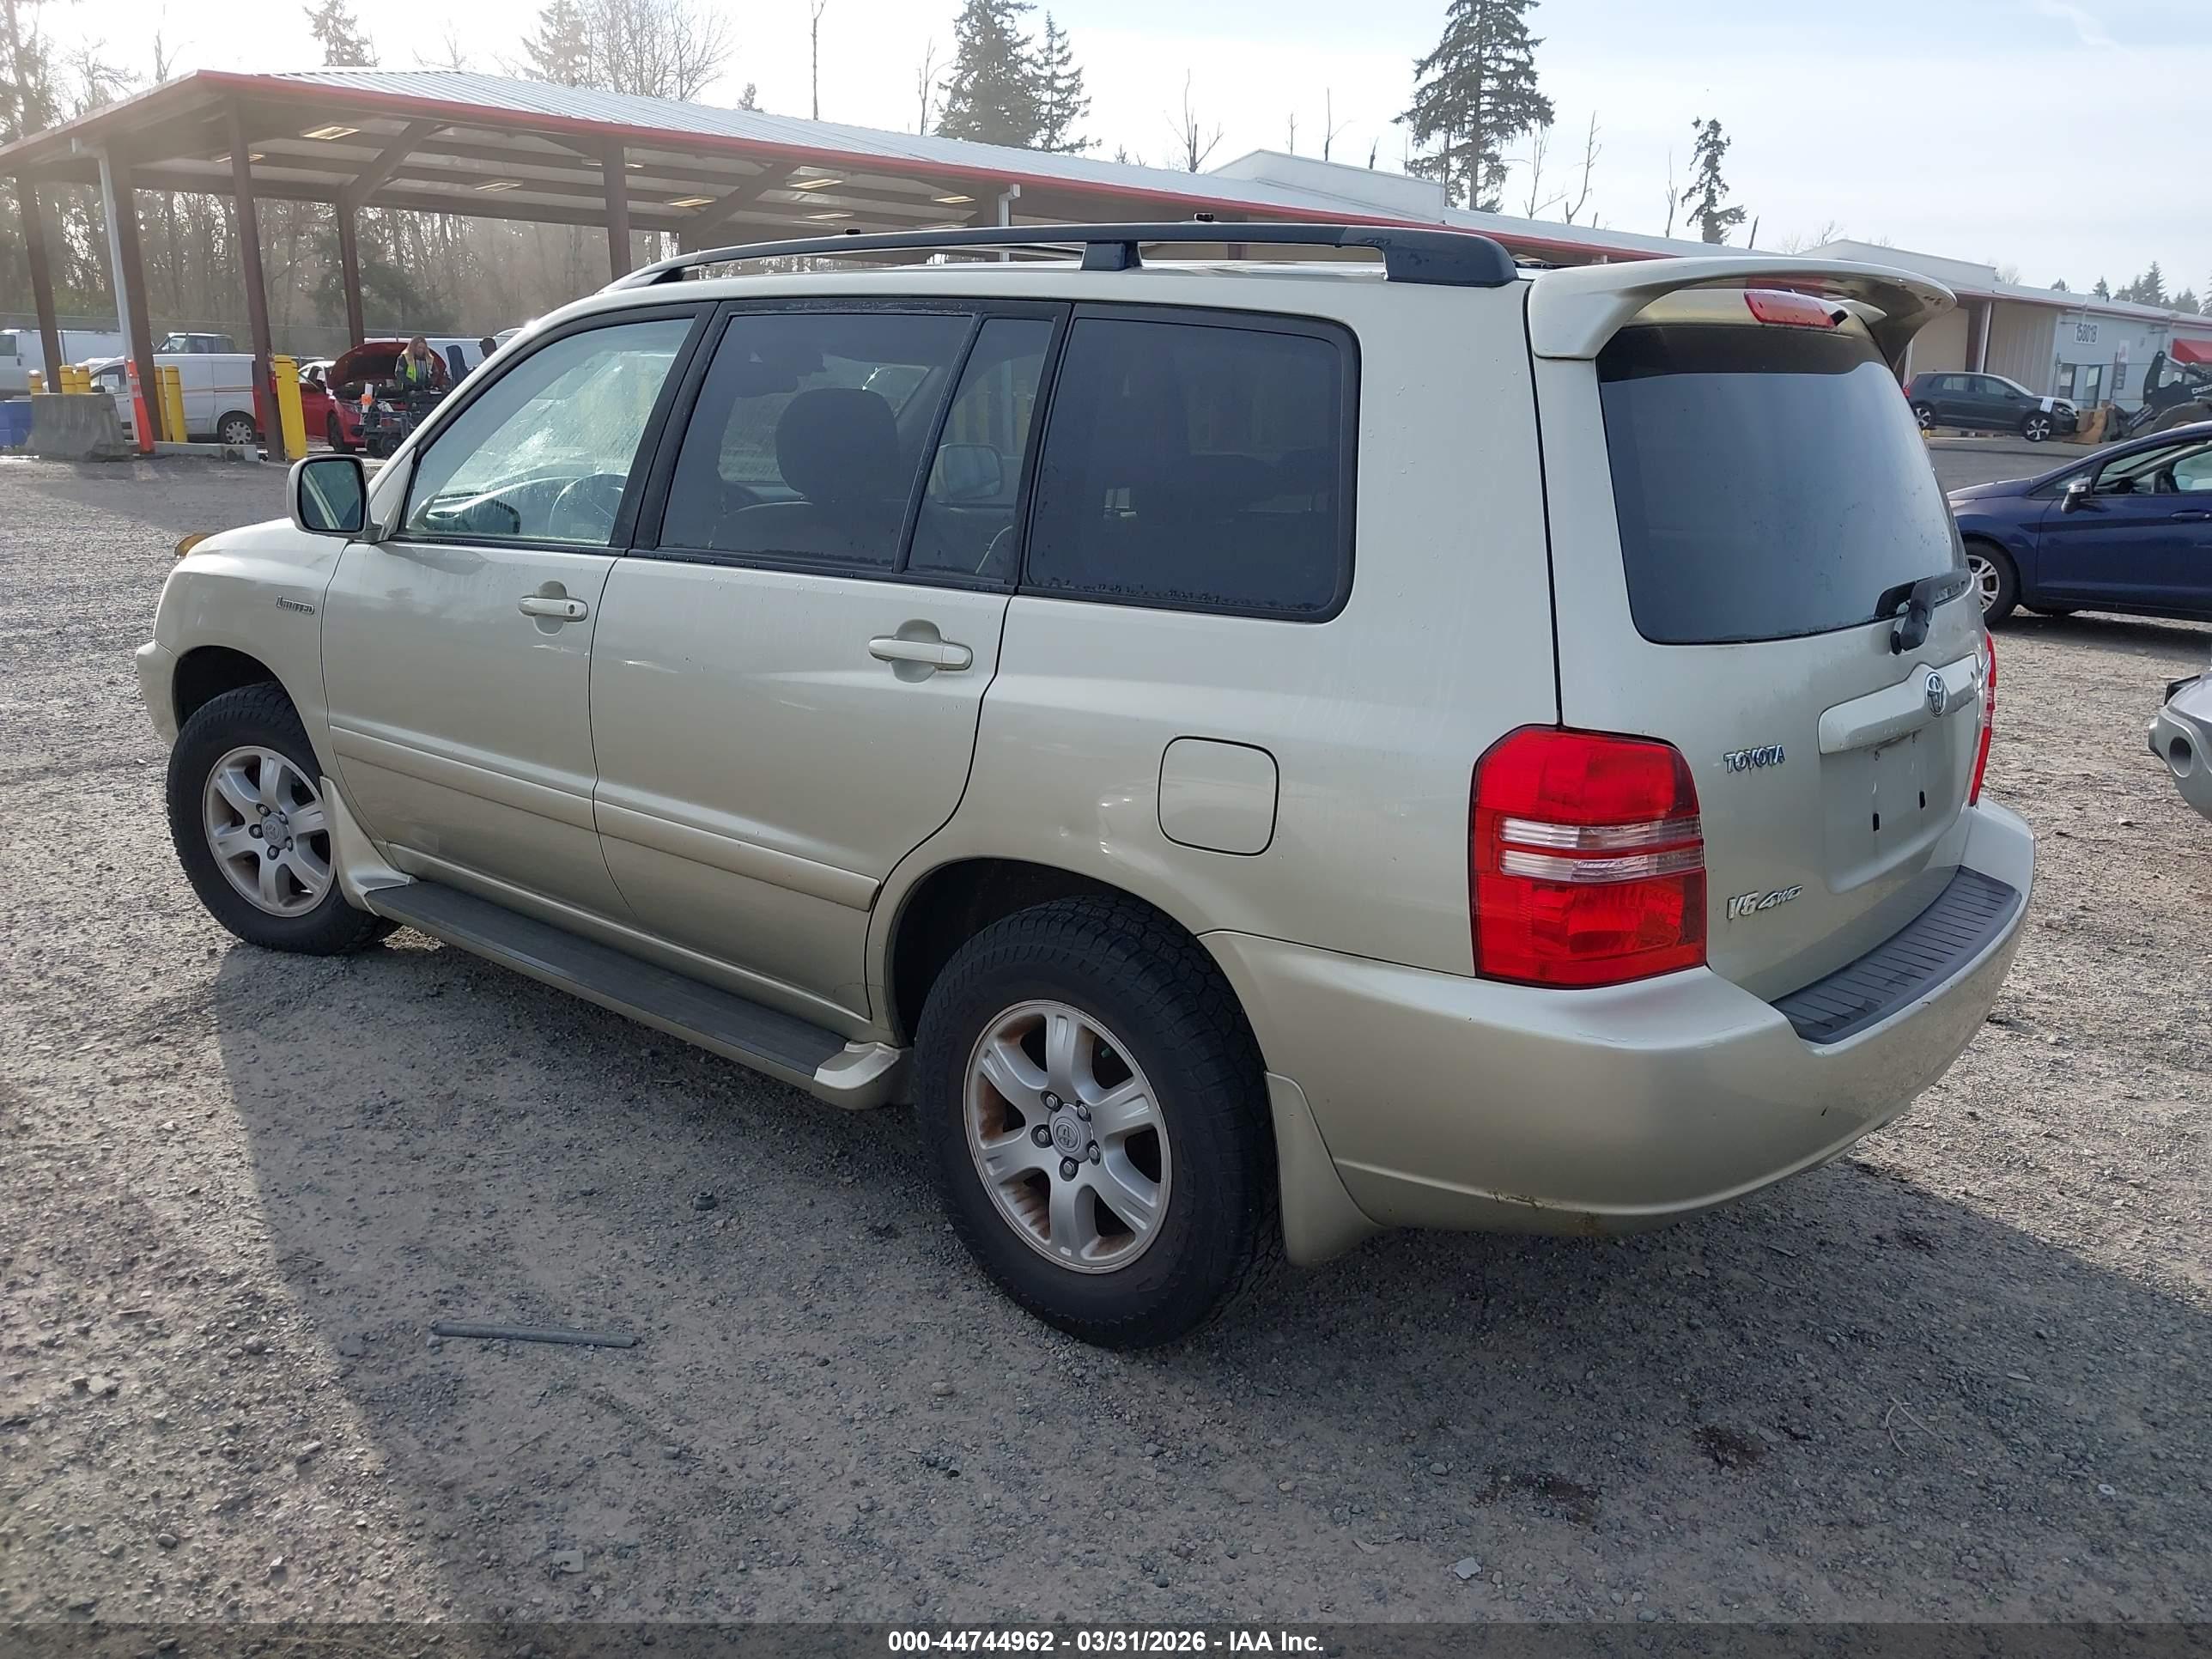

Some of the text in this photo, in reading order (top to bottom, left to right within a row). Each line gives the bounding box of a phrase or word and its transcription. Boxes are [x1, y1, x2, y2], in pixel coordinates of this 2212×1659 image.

[1723, 744, 1786, 774] TOYOTA
[1727, 884, 1803, 920] V6 4WD
